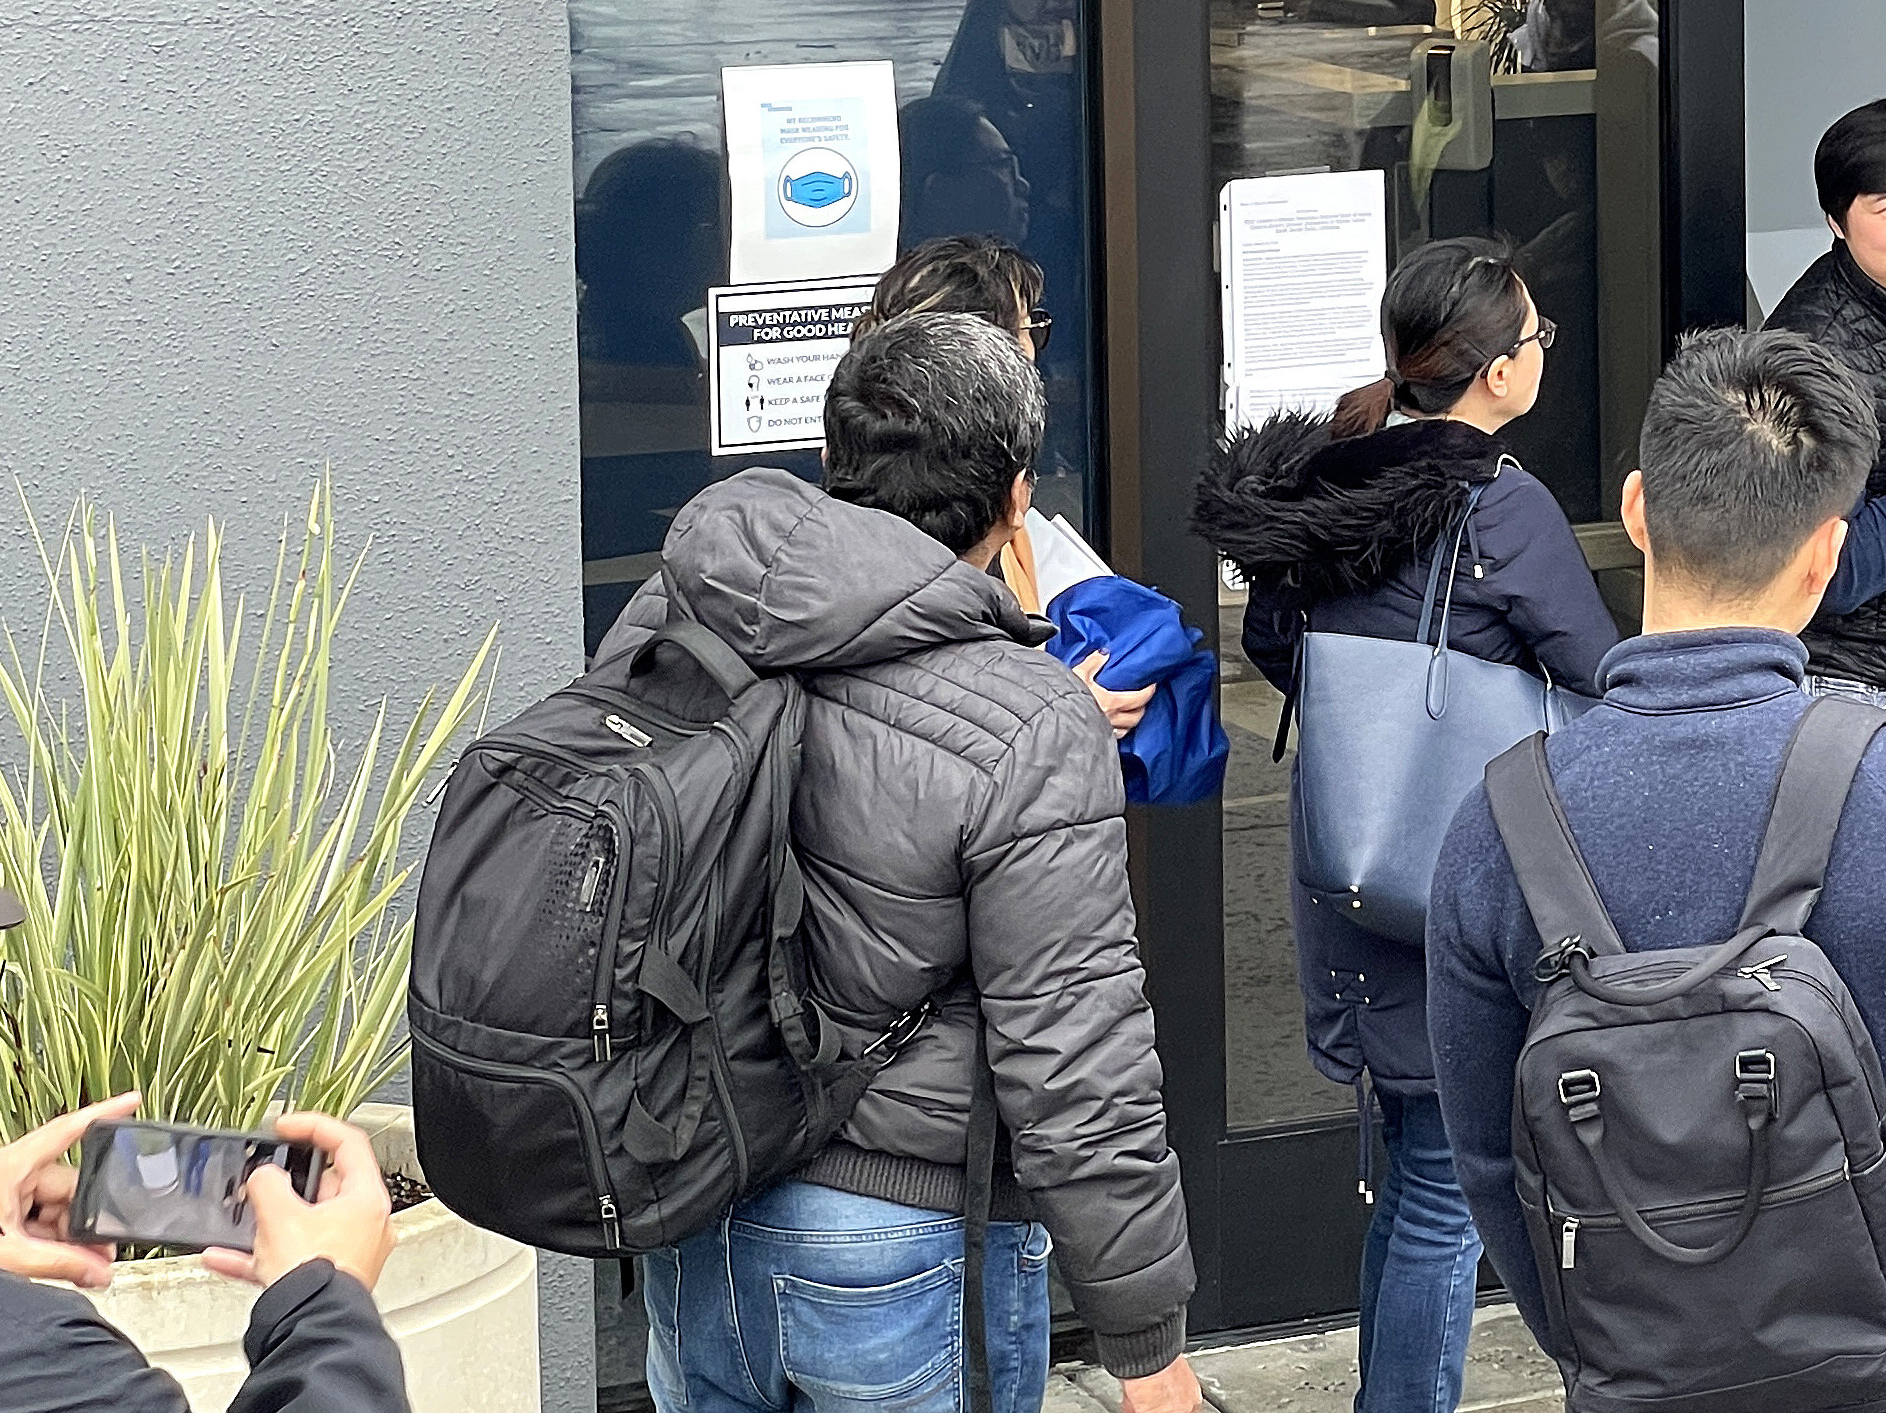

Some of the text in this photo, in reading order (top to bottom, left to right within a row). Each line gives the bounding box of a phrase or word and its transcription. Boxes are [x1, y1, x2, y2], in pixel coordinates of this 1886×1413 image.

[729, 308, 830, 328] PREVENTATIVE
[753, 329, 782, 341] FOR
[783, 324, 826, 339] GOOD
[795, 354, 821, 363] YOUR
[767, 376, 794, 385] WEAR
[804, 373, 826, 382] FACE
[768, 397, 790, 405] KEEP
[800, 395, 821, 403] SAFE
[768, 419, 782, 427] DO
[783, 417, 803, 425] NOT
